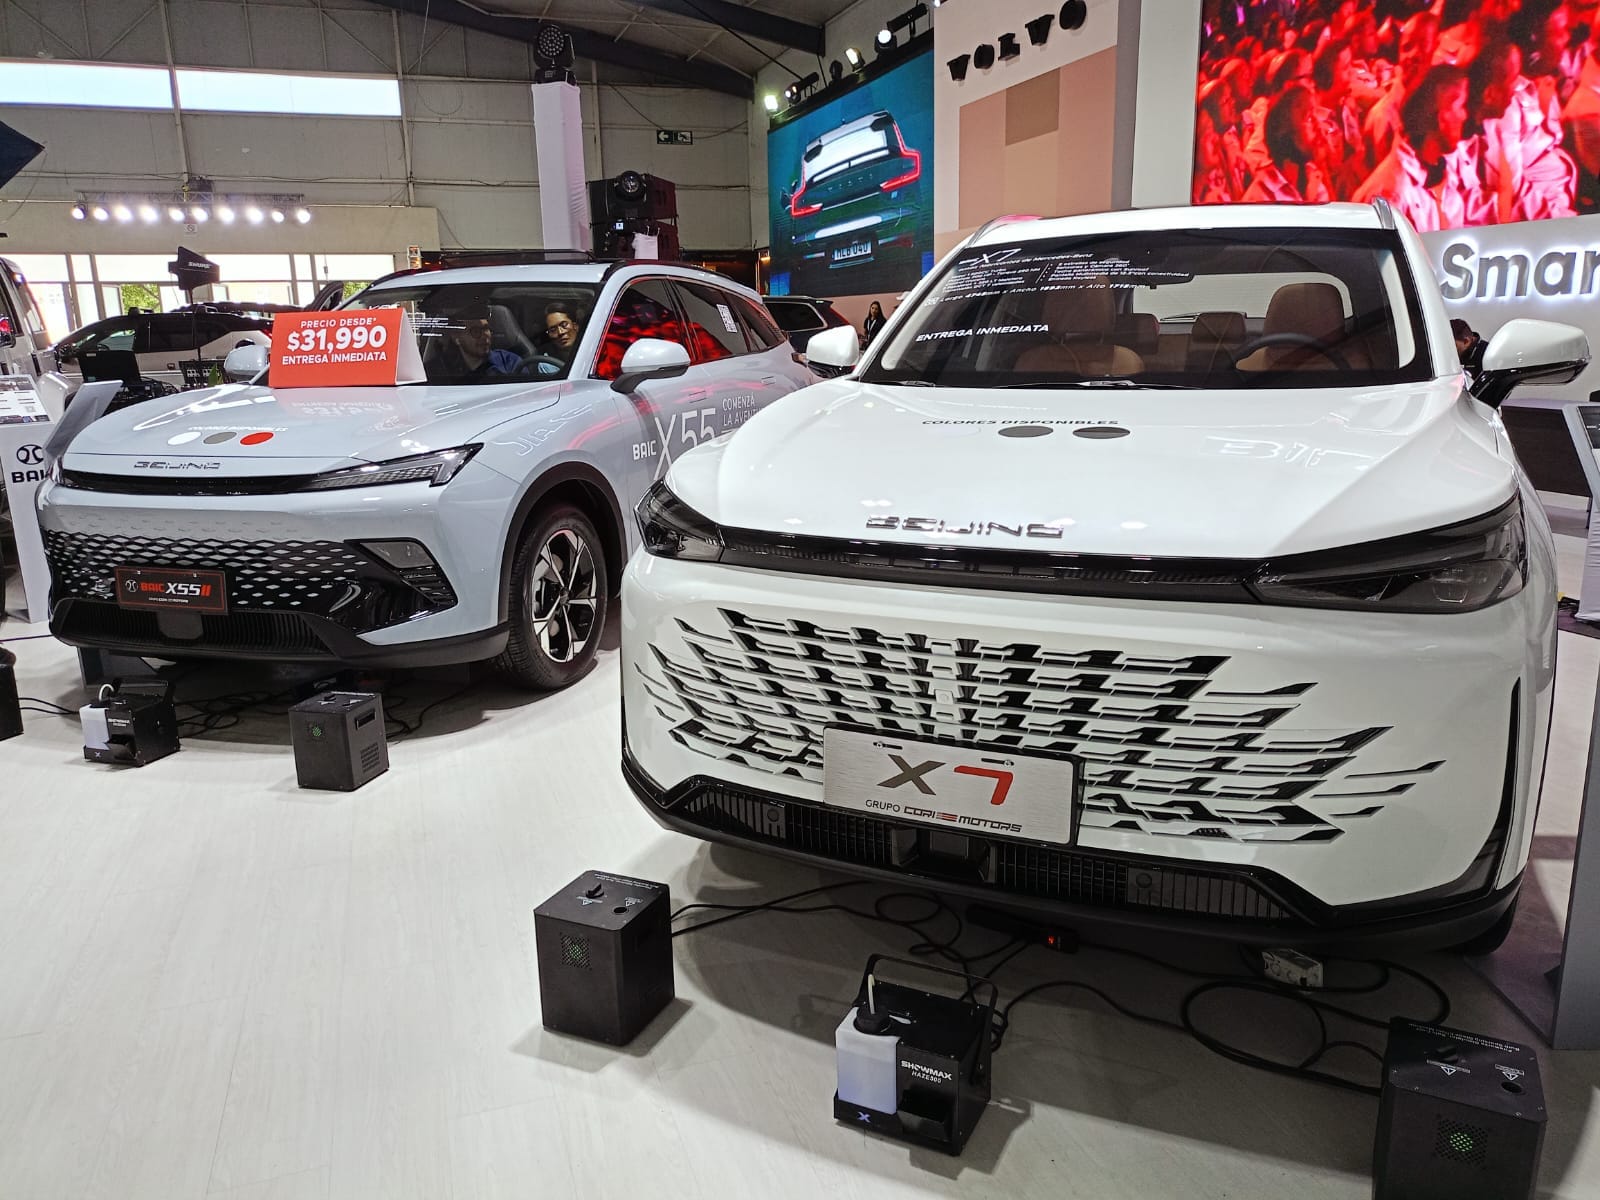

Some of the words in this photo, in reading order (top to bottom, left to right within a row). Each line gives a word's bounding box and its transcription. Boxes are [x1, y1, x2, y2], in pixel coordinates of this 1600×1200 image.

[947, 0, 1087, 81] VOLVO
[300, 320, 336, 328] PRECIO
[287, 326, 386, 353] $31,990
[916, 328, 973, 342] ENTREGA
[976, 324, 1048, 335] INMEDIATA
[282, 354, 328, 365] ENTREGA
[331, 352, 387, 362] INMEDIATA
[723, 414, 732, 426] LA
[632, 440, 656, 460] BAIC
[654, 408, 716, 481] X55
[134, 461, 221, 470] BEIJING
[866, 516, 1064, 539] BEIJING
[140, 582, 165, 593] BAIC
[865, 800, 900, 812] GRUPO
[901, 1060, 952, 1080] SHOWMAX
